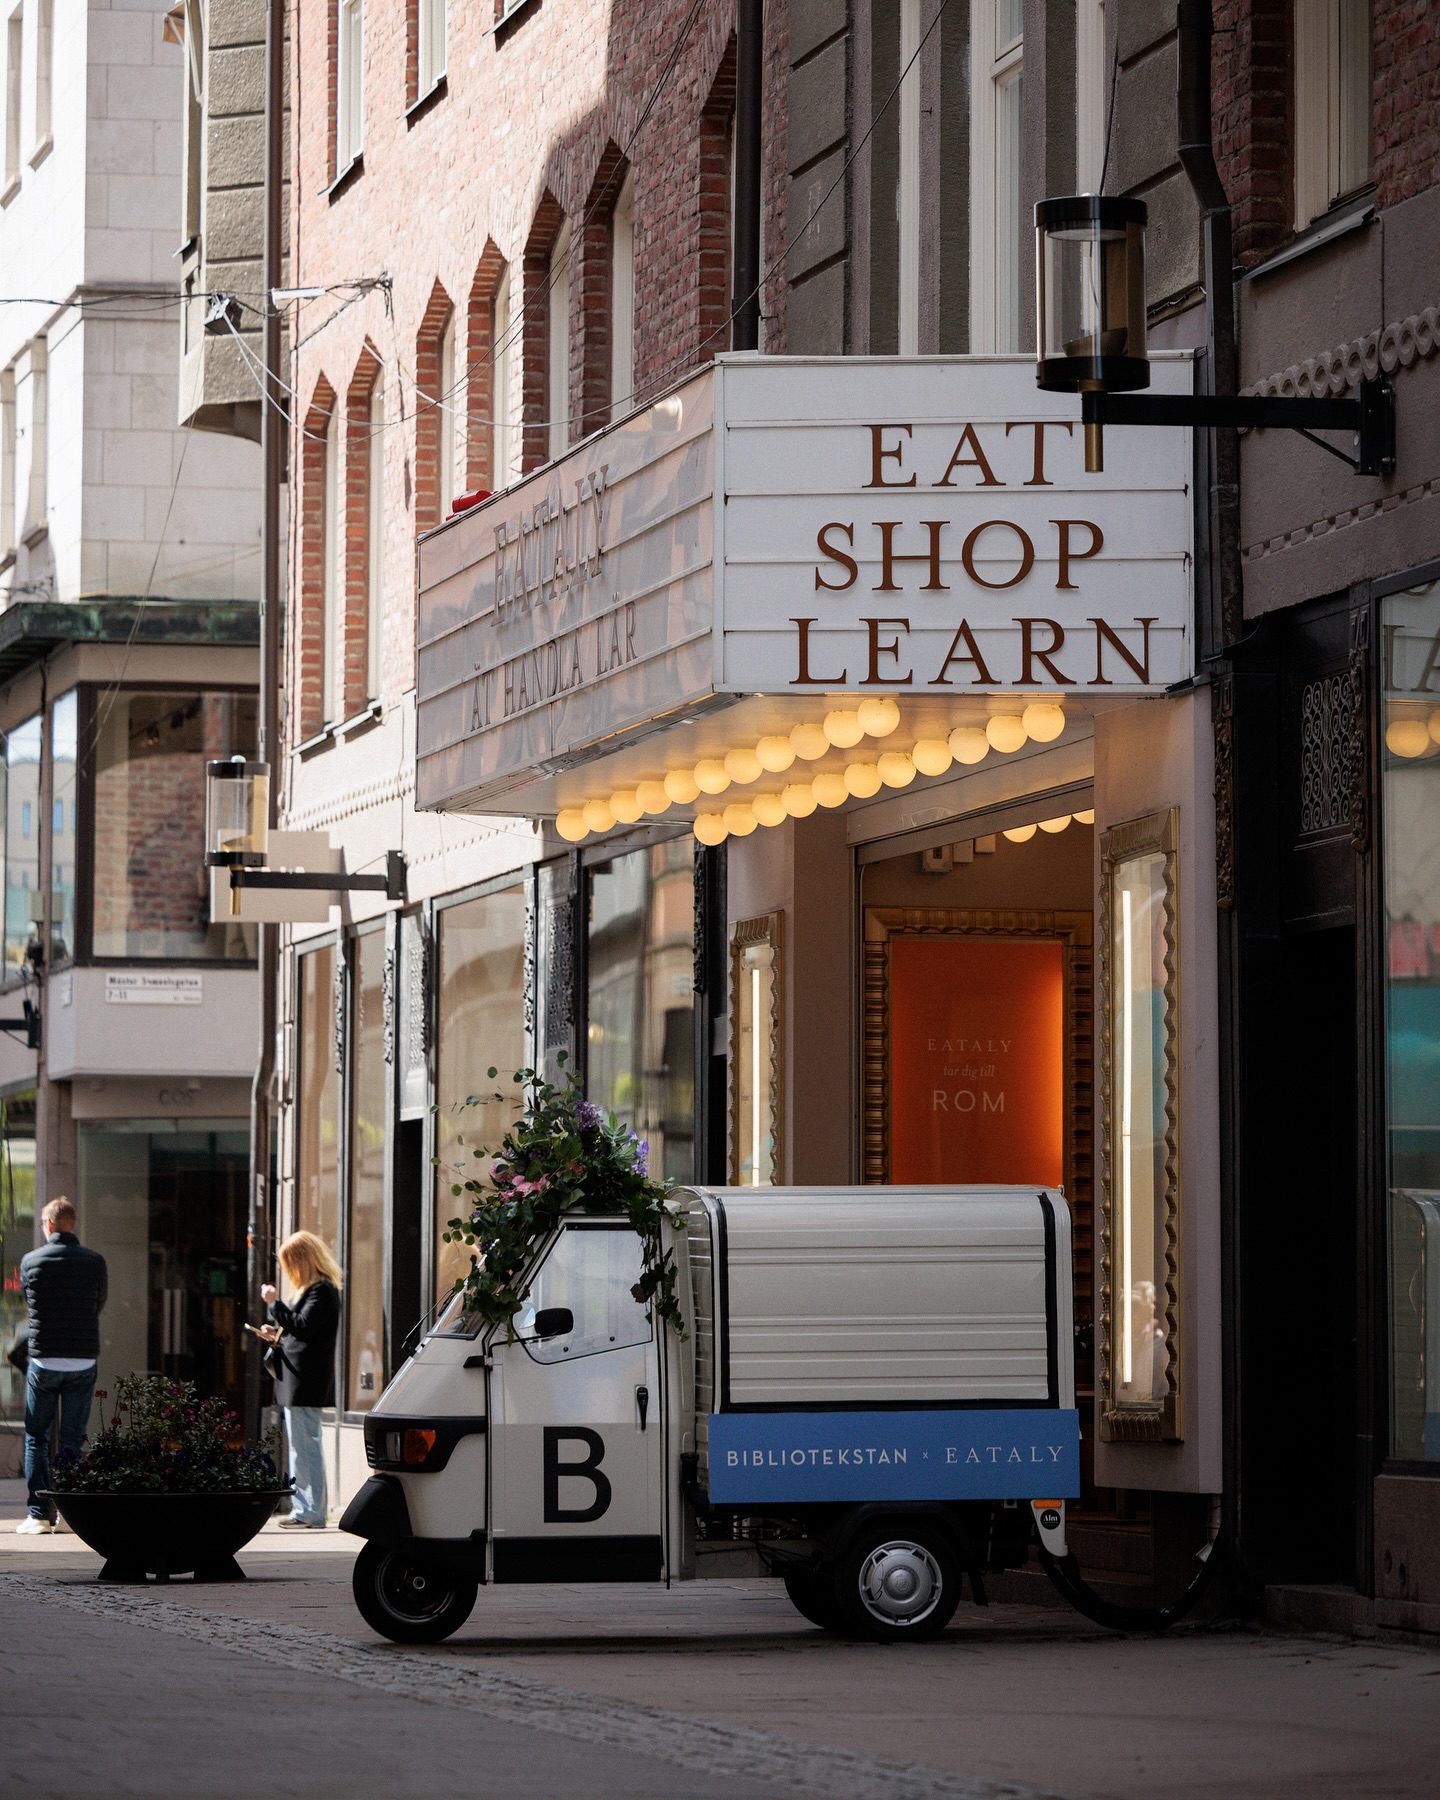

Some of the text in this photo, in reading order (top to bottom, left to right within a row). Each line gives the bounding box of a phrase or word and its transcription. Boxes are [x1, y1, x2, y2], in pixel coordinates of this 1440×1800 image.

[862, 422, 1073, 488] EAT
[491, 464, 609, 627] EATALY
[815, 520, 1104, 591] SHOP
[503, 629, 583, 717] HANDLA
[789, 618, 1159, 685] LEARN
[928, 1039, 1011, 1052] EATALY
[962, 1065, 976, 1081] dig
[980, 1065, 995, 1077] till
[933, 1090, 1004, 1112] ROM
[543, 1426, 612, 1523] B
[727, 1449, 907, 1466] BIBLIOTEKSTAN
[946, 1446, 1063, 1464] EATALY
